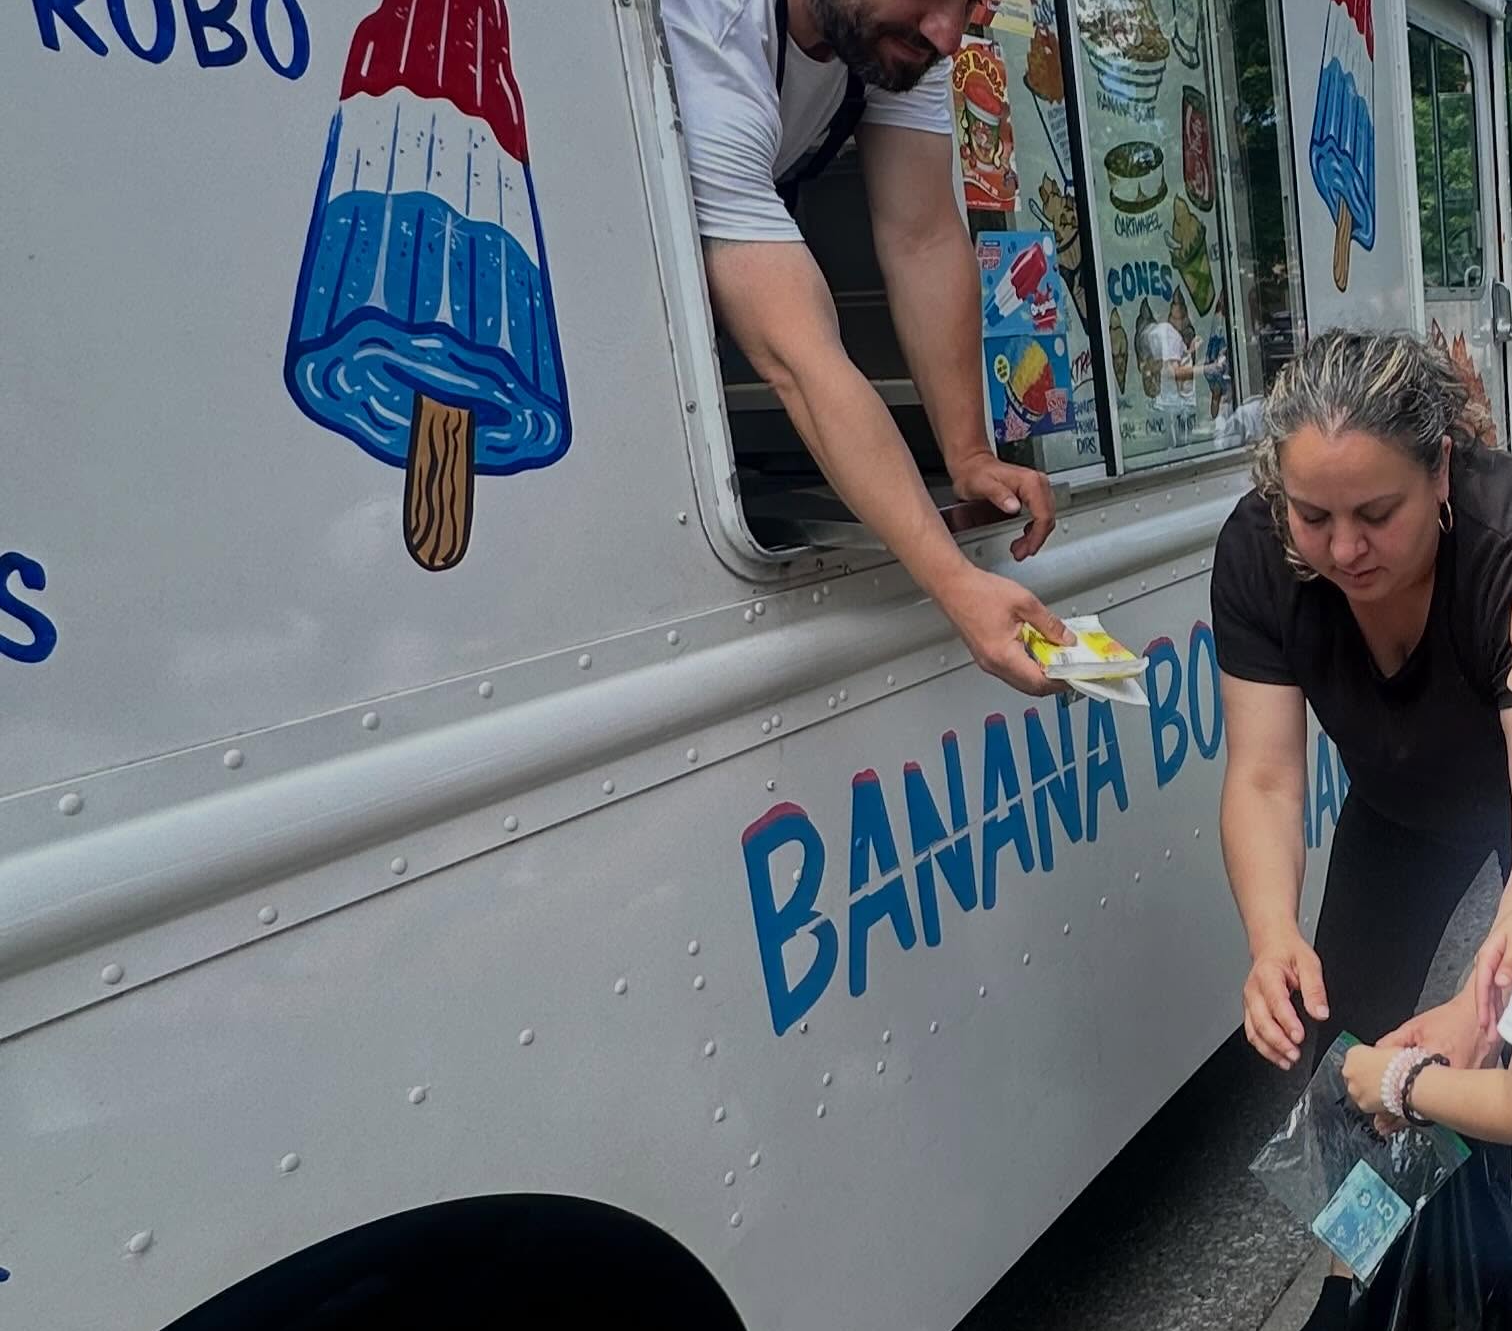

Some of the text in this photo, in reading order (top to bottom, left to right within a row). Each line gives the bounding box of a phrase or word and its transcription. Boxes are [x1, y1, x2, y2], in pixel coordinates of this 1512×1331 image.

[1107, 260, 1173, 307] CONES
[741, 690, 1129, 1037] BANANA
[1143, 620, 1226, 790] BO
[1375, 1197, 1395, 1221] 5
